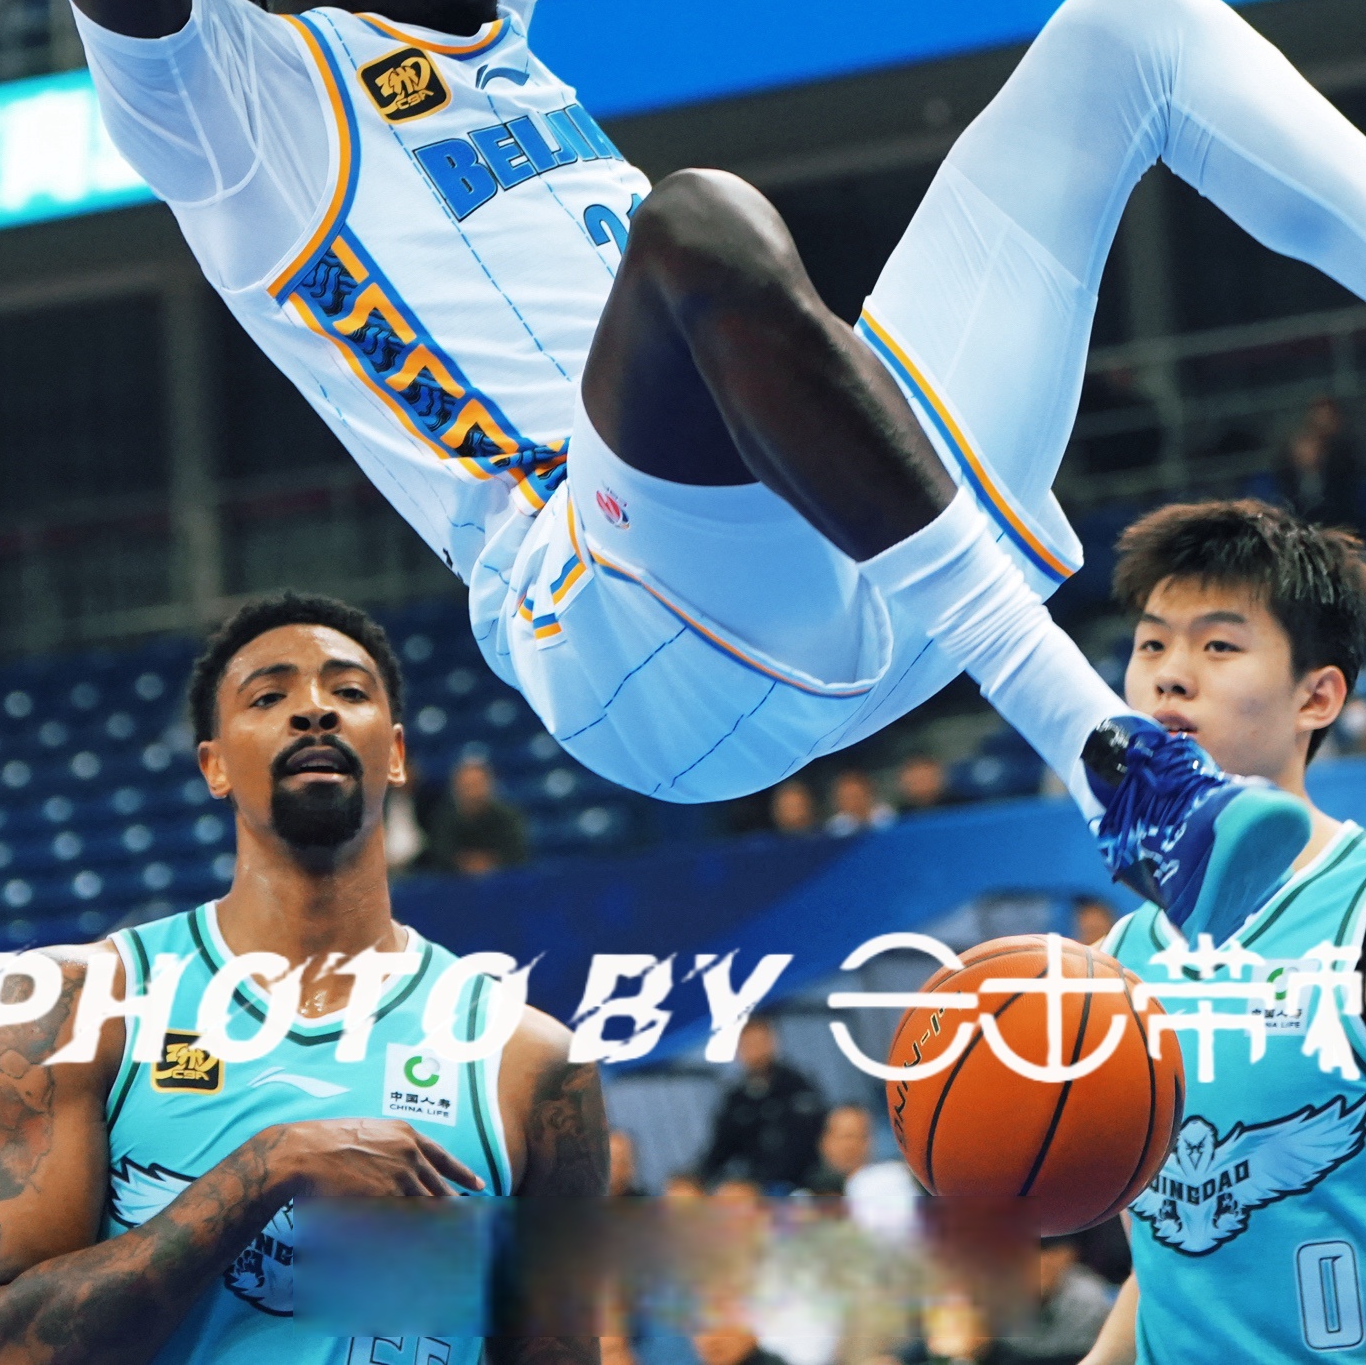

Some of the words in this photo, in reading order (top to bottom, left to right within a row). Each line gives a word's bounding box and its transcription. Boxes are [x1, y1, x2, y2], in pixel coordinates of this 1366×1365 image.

[395, 88, 435, 111] CBA
[583, 193, 644, 258] 2
[171, 1067, 210, 1082] CBA
[390, 1091, 451, 1109] 中国人寿
[389, 1103, 423, 1113] CHINA
[427, 1109, 449, 1118] LIFE
[1297, 1240, 1365, 1350] 0
